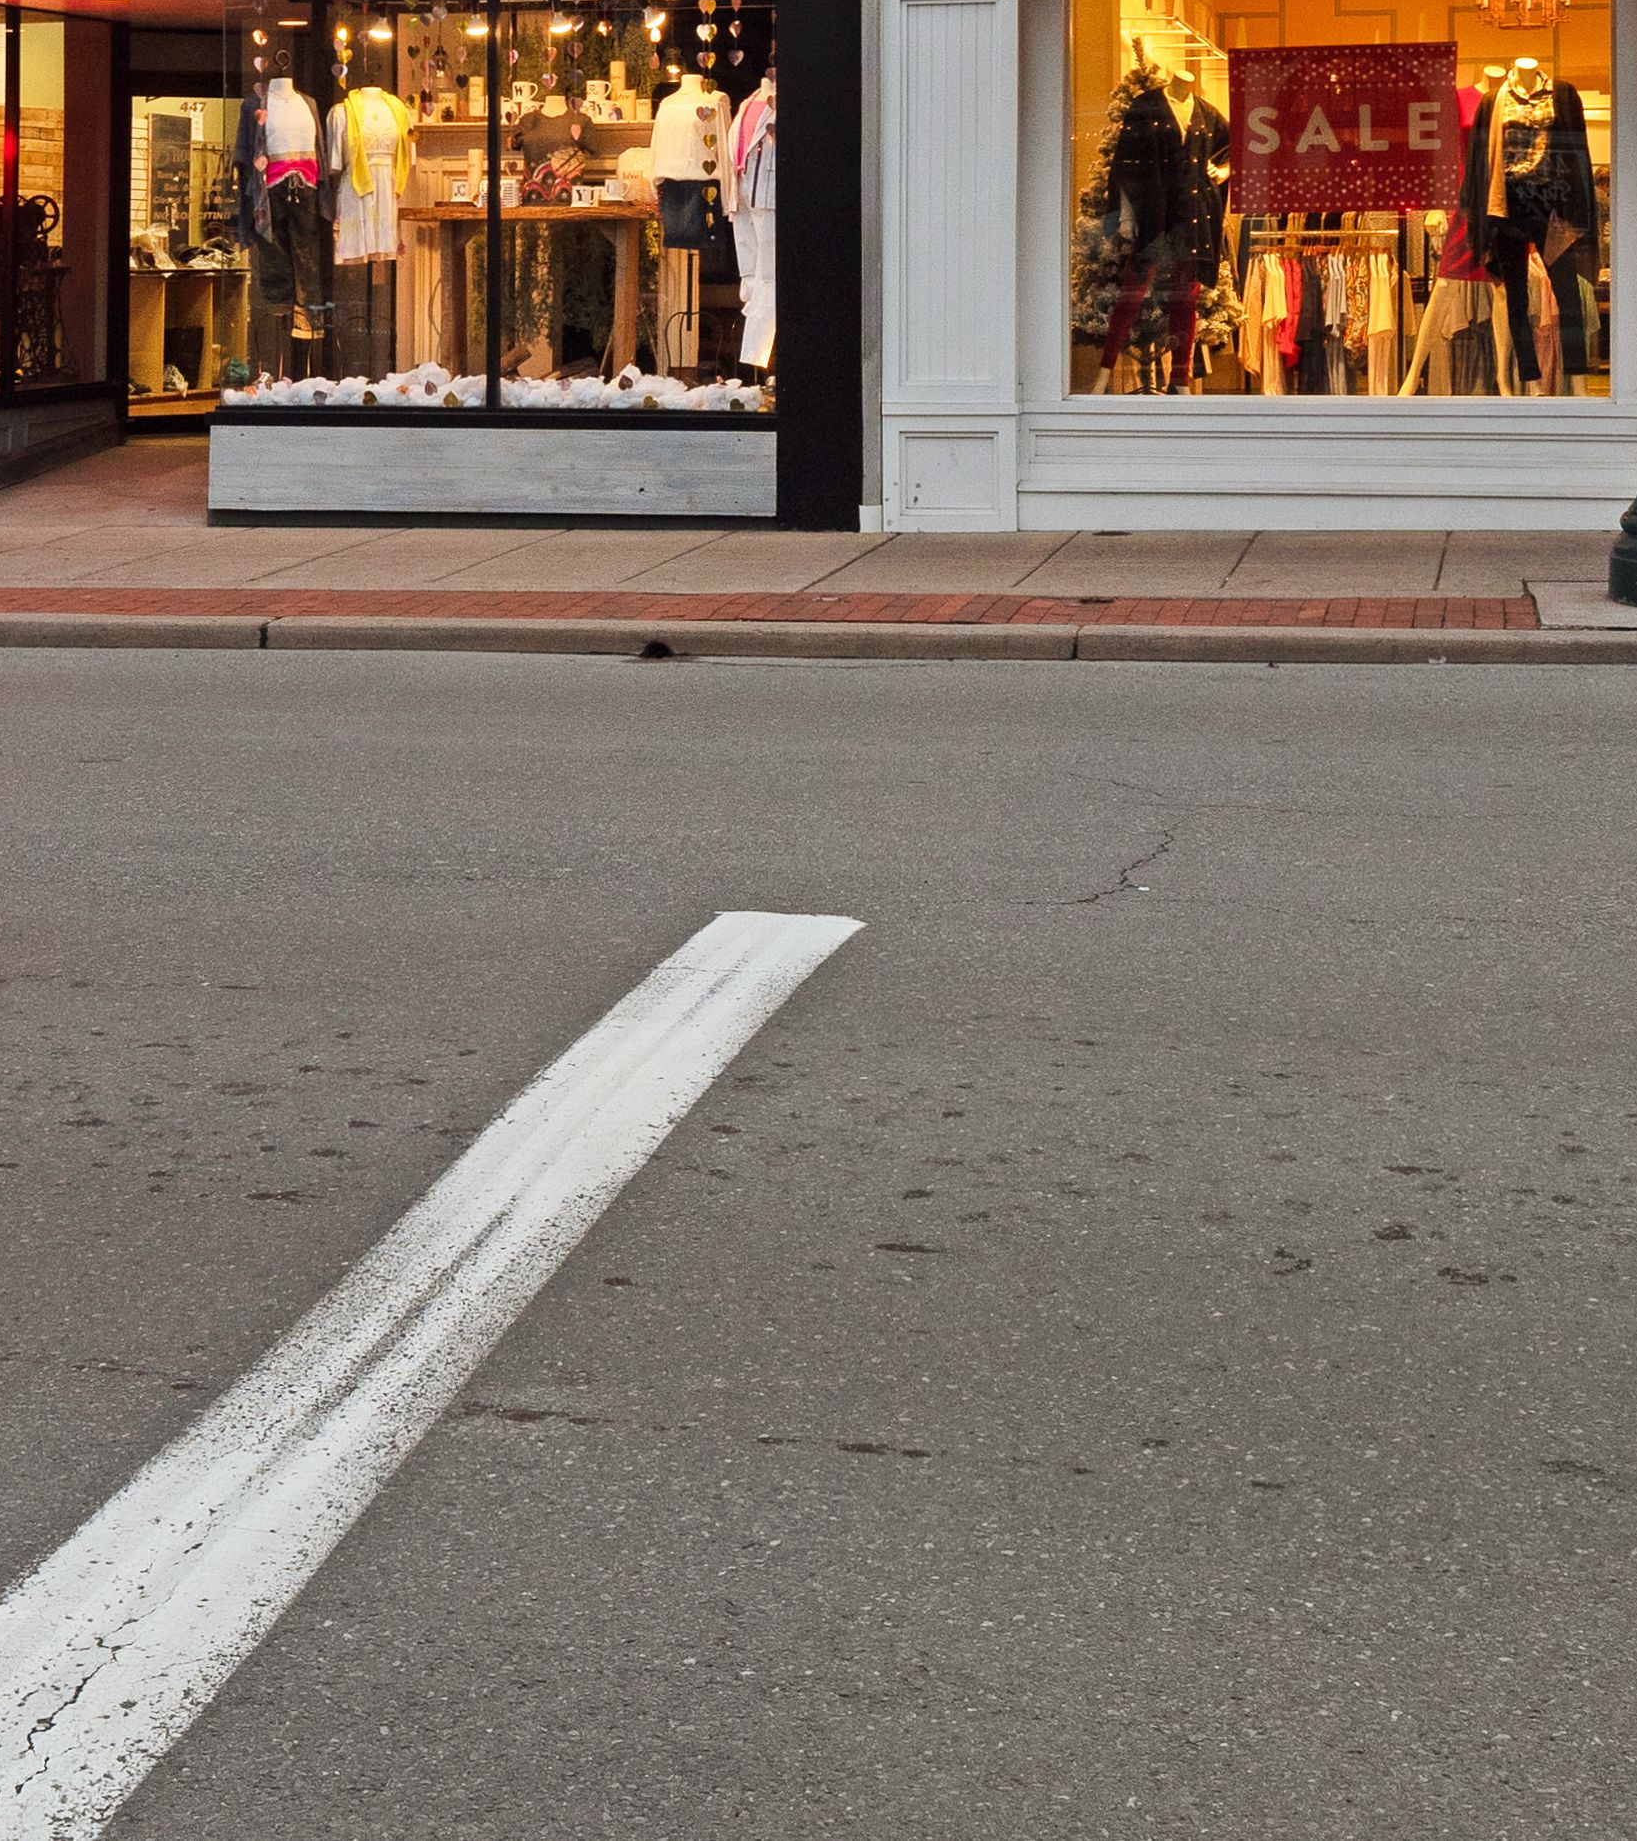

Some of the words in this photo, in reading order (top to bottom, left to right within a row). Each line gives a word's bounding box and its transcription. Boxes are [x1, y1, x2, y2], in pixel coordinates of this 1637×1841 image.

[179, 102, 206, 112] 447
[1247, 102, 1441, 154] SALE
[172, 211, 231, 220] SOCITING
